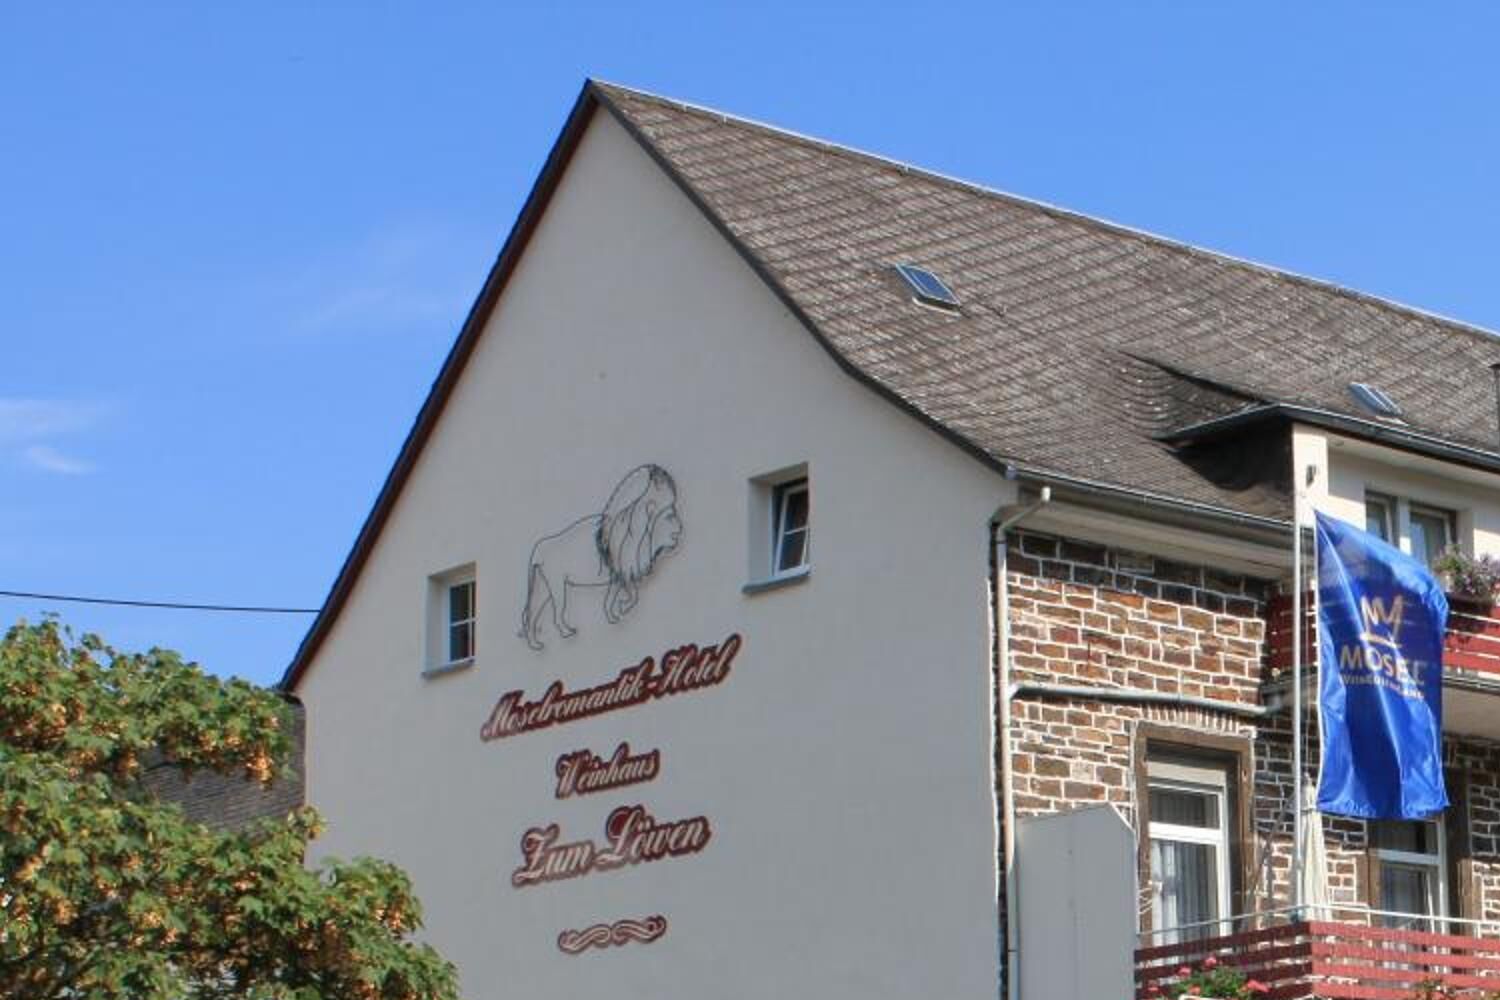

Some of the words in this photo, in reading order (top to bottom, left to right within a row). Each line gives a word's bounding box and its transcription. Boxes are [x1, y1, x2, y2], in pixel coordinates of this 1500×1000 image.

[555, 742, 660, 799] Weinhaus
[512, 824, 596, 888] Zum
[596, 804, 712, 871] Löwen
